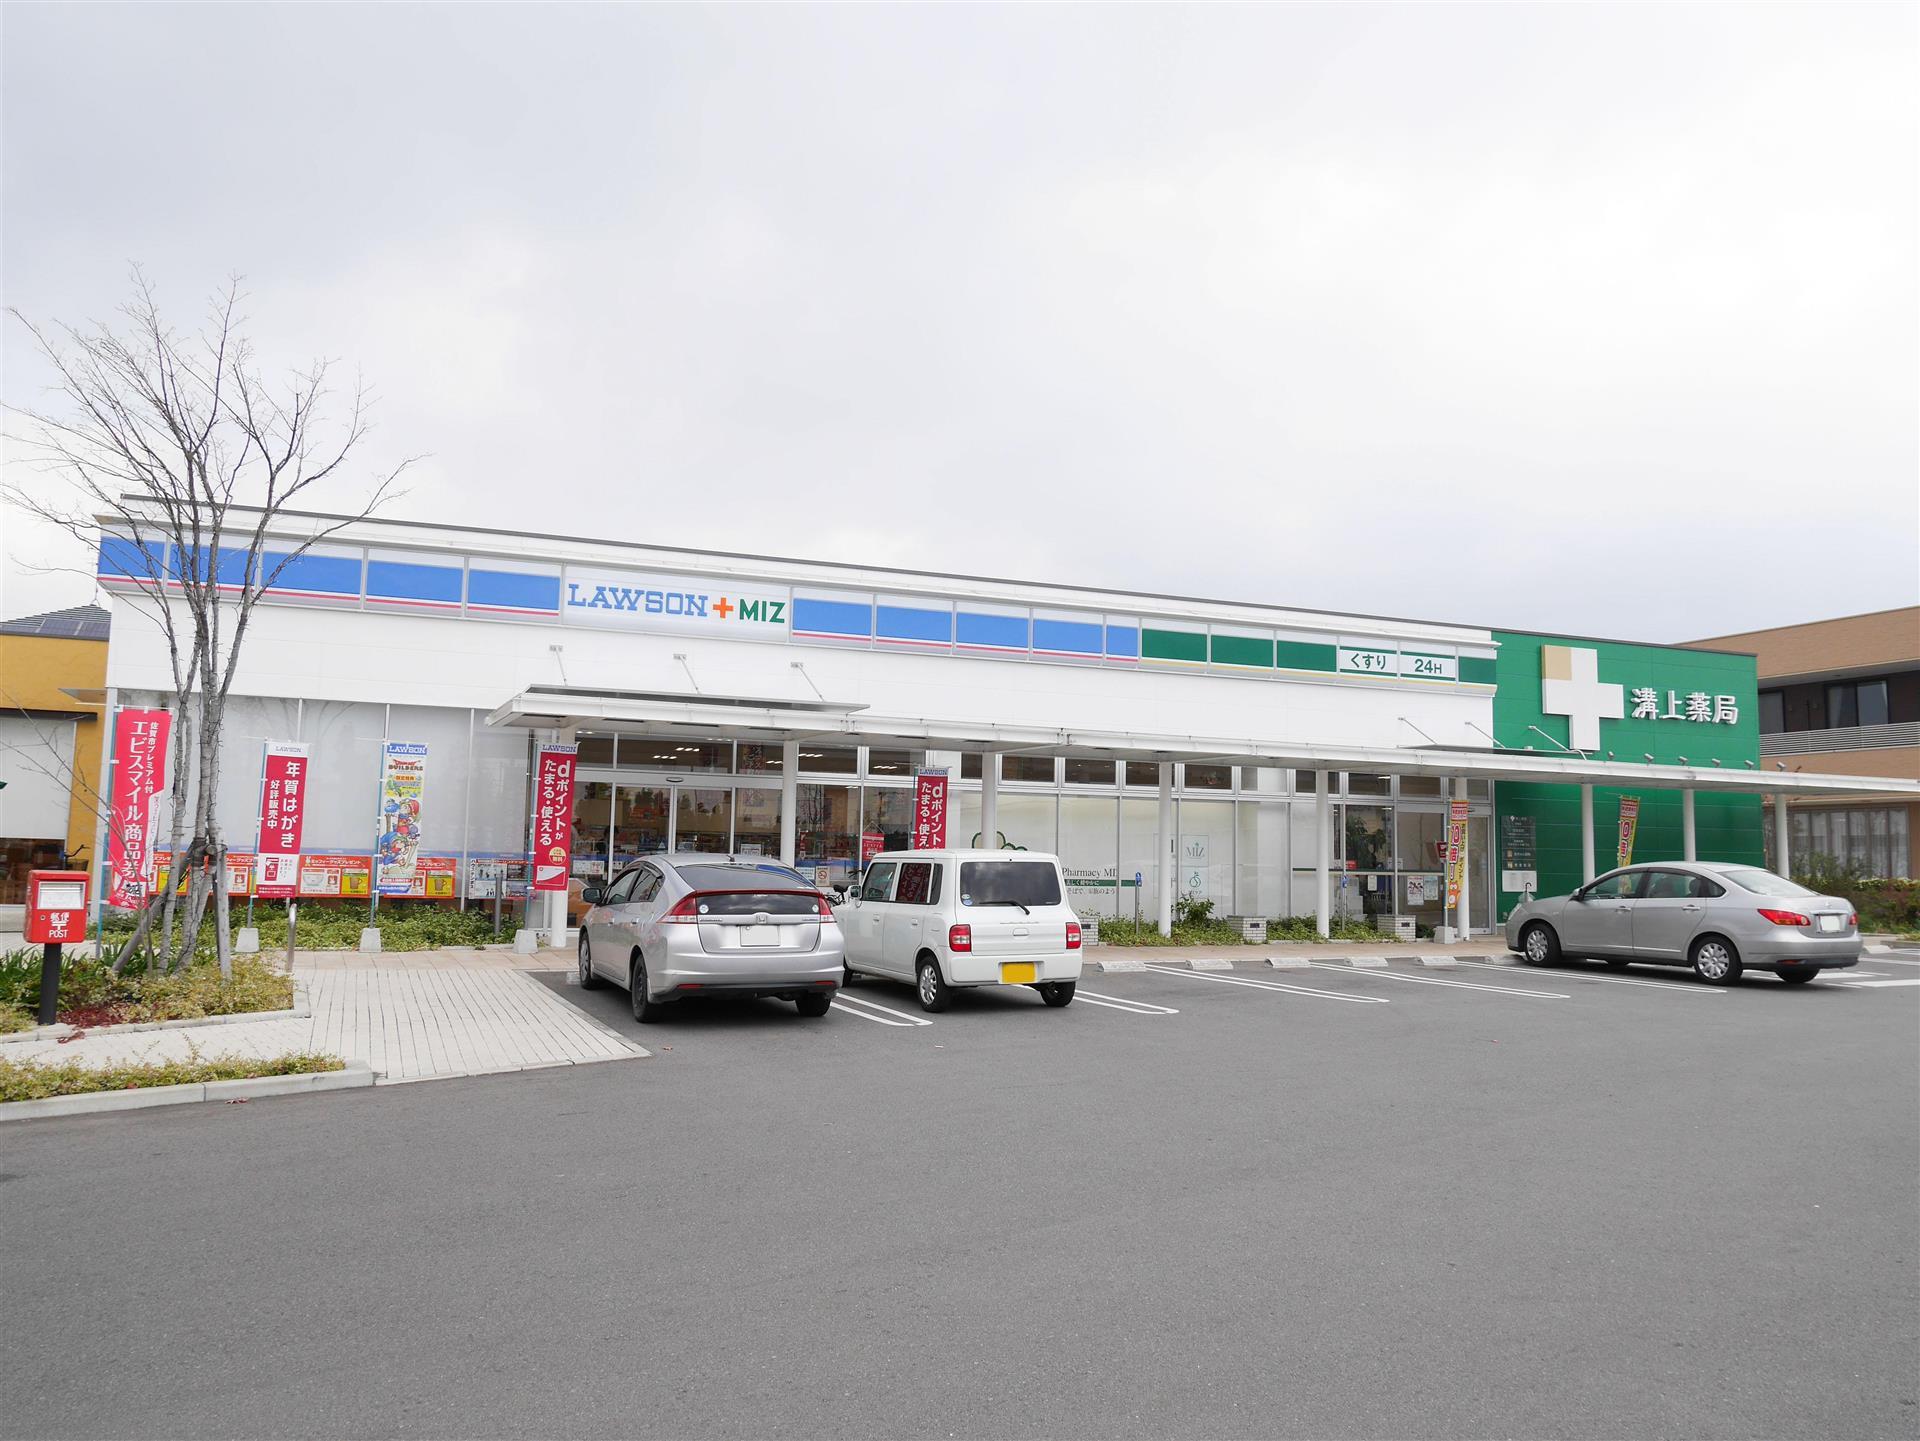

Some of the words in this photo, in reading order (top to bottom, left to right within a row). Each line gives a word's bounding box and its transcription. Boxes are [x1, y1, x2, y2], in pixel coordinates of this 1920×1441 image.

[568, 583, 709, 617] LAWSON
[739, 598, 786, 624] MIZ
[1350, 653, 1386, 670] くすり
[1414, 658, 1442, 674] 24H
[1630, 687, 1739, 725] 溝上薬局
[144, 721, 160, 794] 佐賀市プレミアム付
[388, 745, 426, 754] LAWSON
[542, 744, 577, 753] LAWSON
[919, 768, 947, 776] LAWSON
[120, 721, 149, 879] エビスマイル商品券
[267, 779, 281, 829] 好評販売中
[280, 761, 301, 848] 年賀はがき
[554, 759, 571, 840] dポイントが
[931, 782, 943, 849] dポイント
[1062, 868, 1101, 879] Pharmacy
[1103, 869, 1116, 877] MI
[49, 930, 68, 938] POST
